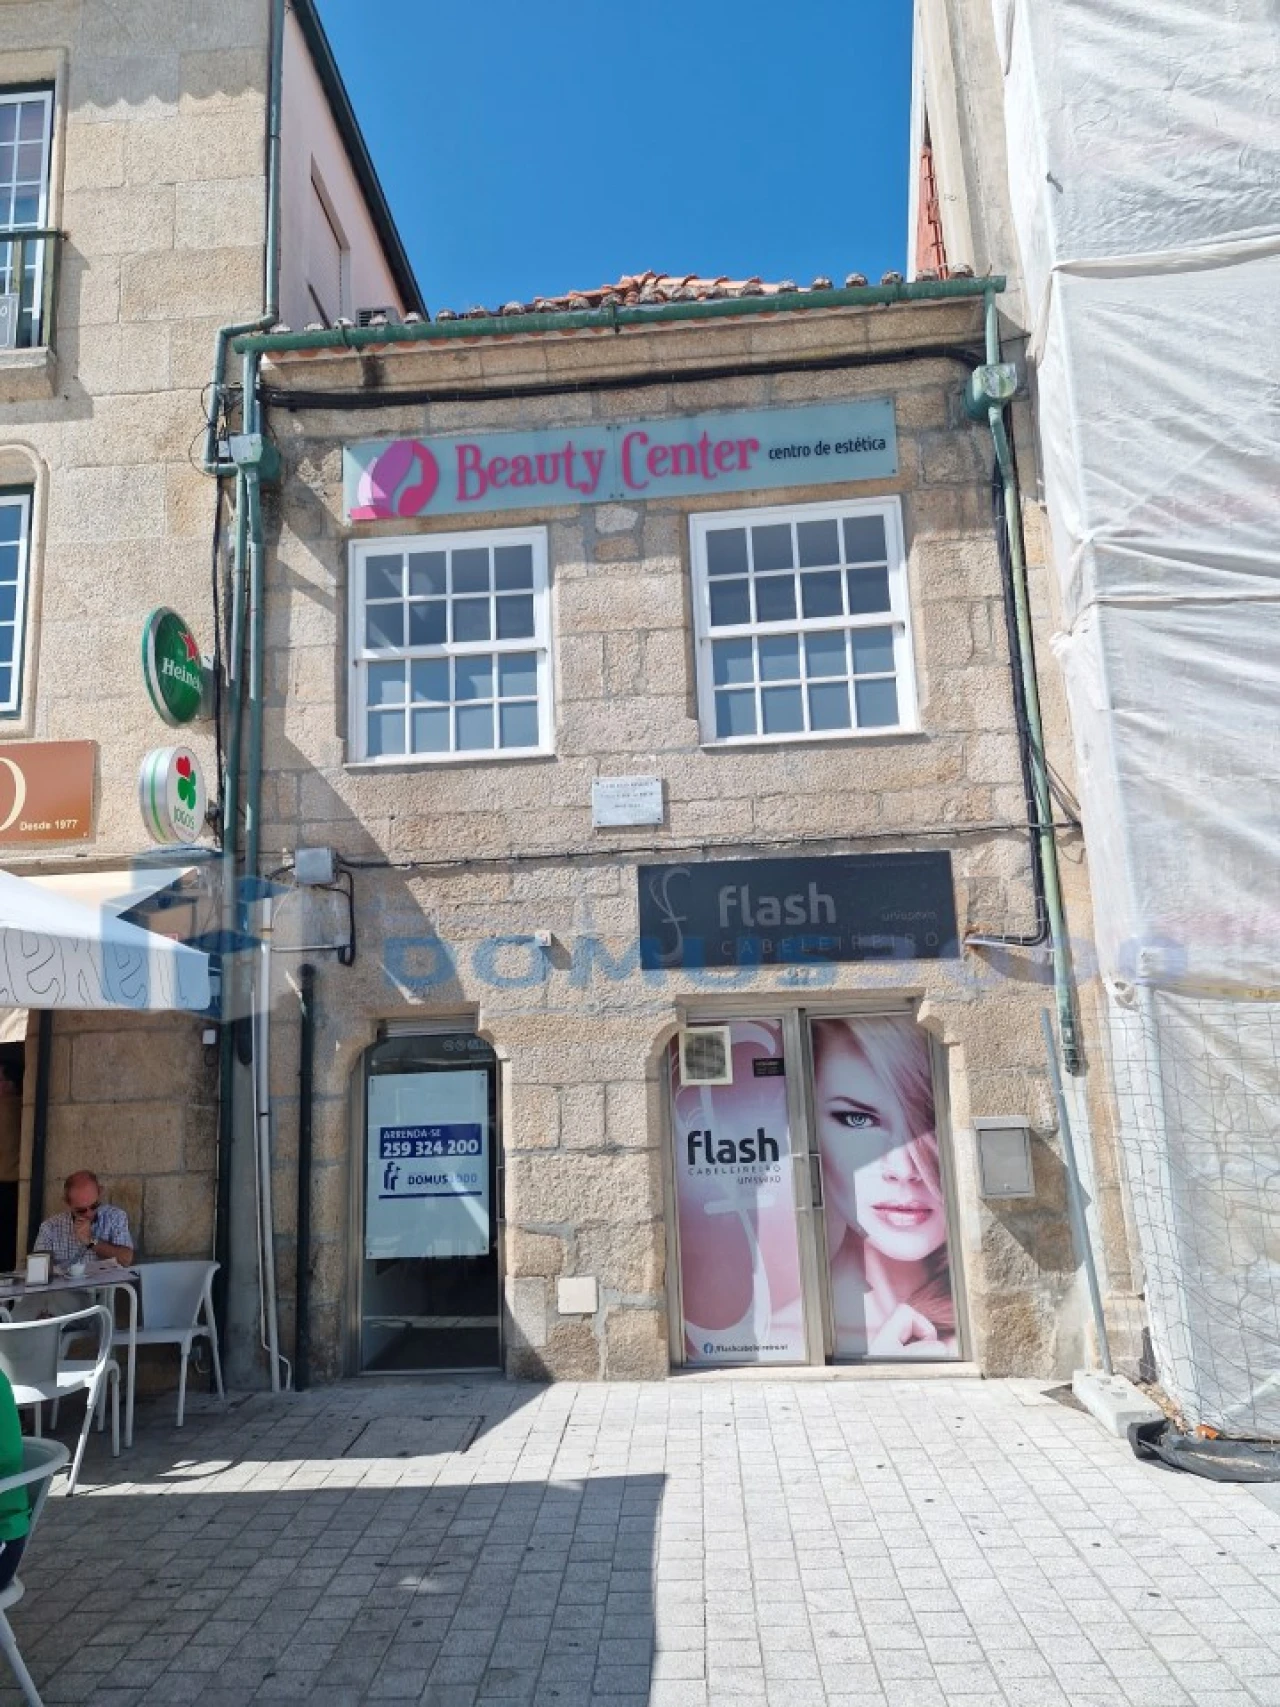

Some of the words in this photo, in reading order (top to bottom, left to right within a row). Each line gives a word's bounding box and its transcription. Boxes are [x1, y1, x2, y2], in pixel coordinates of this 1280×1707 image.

[768, 443, 812, 460] centro
[813, 440, 831, 456] de
[835, 436, 887, 454] estética
[455, 440, 605, 501] Beauty
[621, 430, 760, 490] Center
[19, 820, 52, 831] Desde
[54, 819, 79, 829] 1977
[718, 881, 837, 928] flash
[383, 1128, 442, 1139] ARRENDA-SE
[383, 1142, 412, 1157] 259
[415, 1140, 444, 1155] 324
[447, 1139, 479, 1154] 200
[687, 1127, 780, 1166] flash
